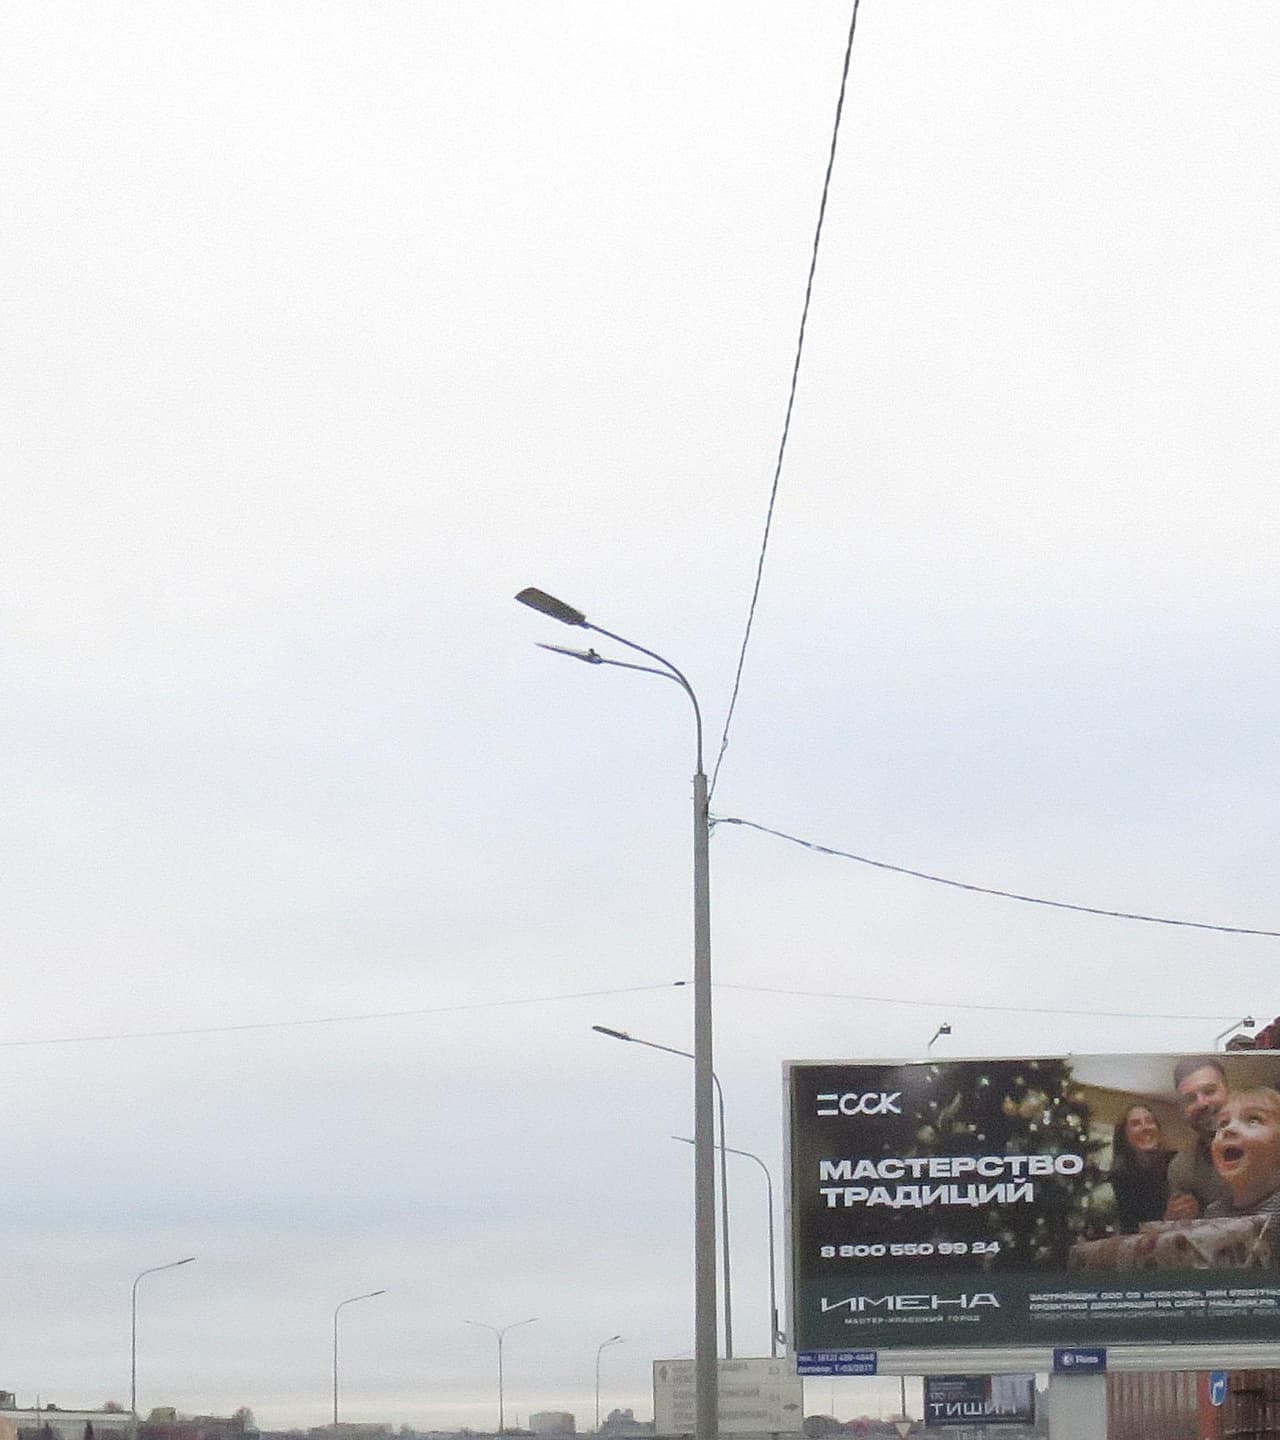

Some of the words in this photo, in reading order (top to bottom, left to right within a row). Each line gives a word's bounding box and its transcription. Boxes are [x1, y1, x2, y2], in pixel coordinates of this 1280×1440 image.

[820, 1154, 1084, 1181] МАСТЕРСТВО
[820, 1177, 1035, 1209] ТРАДИЦИЙ
[820, 1246, 836, 1258] 8
[839, 1244, 887, 1258] 800
[889, 1243, 934, 1256] 550
[937, 1242, 969, 1255] 99
[971, 1241, 1001, 1254] 24
[821, 1293, 1001, 1313] ИМЕНА
[1029, 1302, 1089, 1311] ПРОЕКТНАЯ
[947, 1314, 981, 1323] ГОРОД
